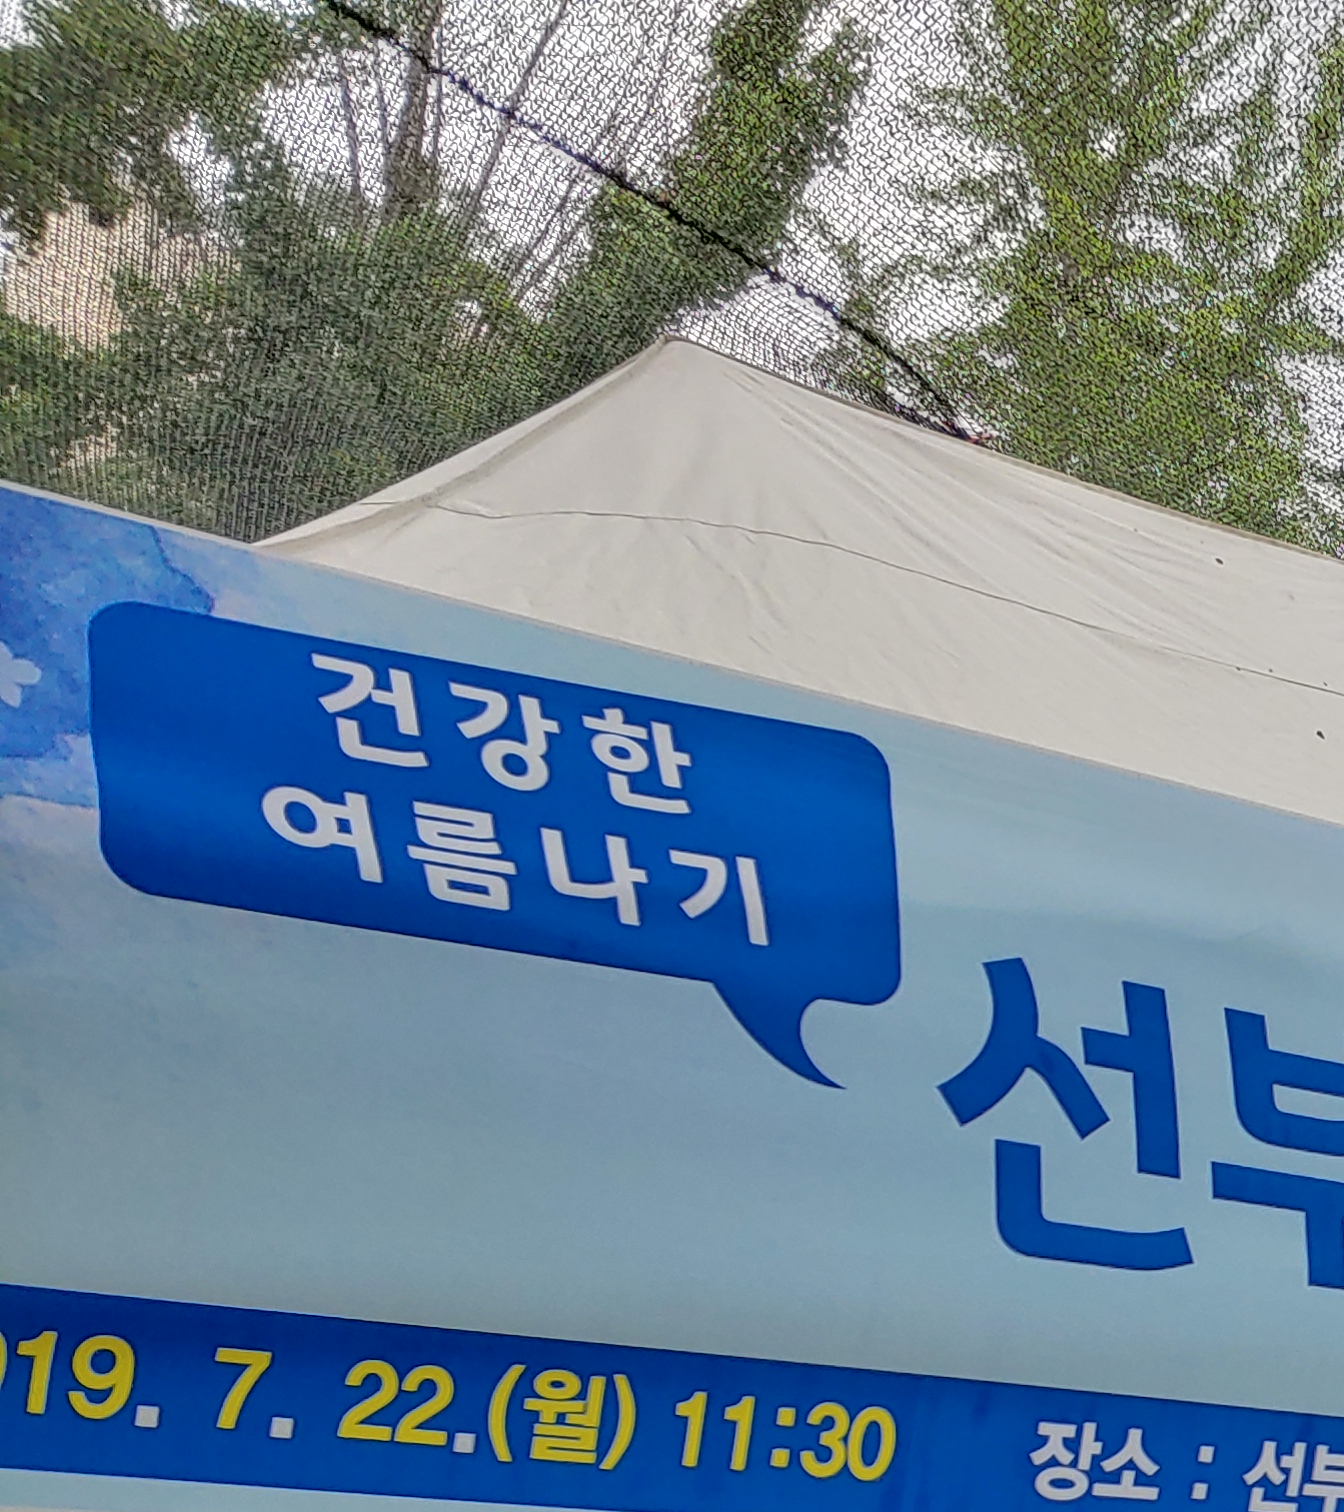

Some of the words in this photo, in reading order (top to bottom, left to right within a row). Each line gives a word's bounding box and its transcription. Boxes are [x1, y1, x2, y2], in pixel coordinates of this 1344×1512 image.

[311, 652, 693, 815] 건강한
[260, 786, 771, 947] 여름나기
[214, 1346, 295, 1440] 7.
[674, 1390, 899, 1483] 11:30
[1029, 1418, 1162, 1504] 장소
